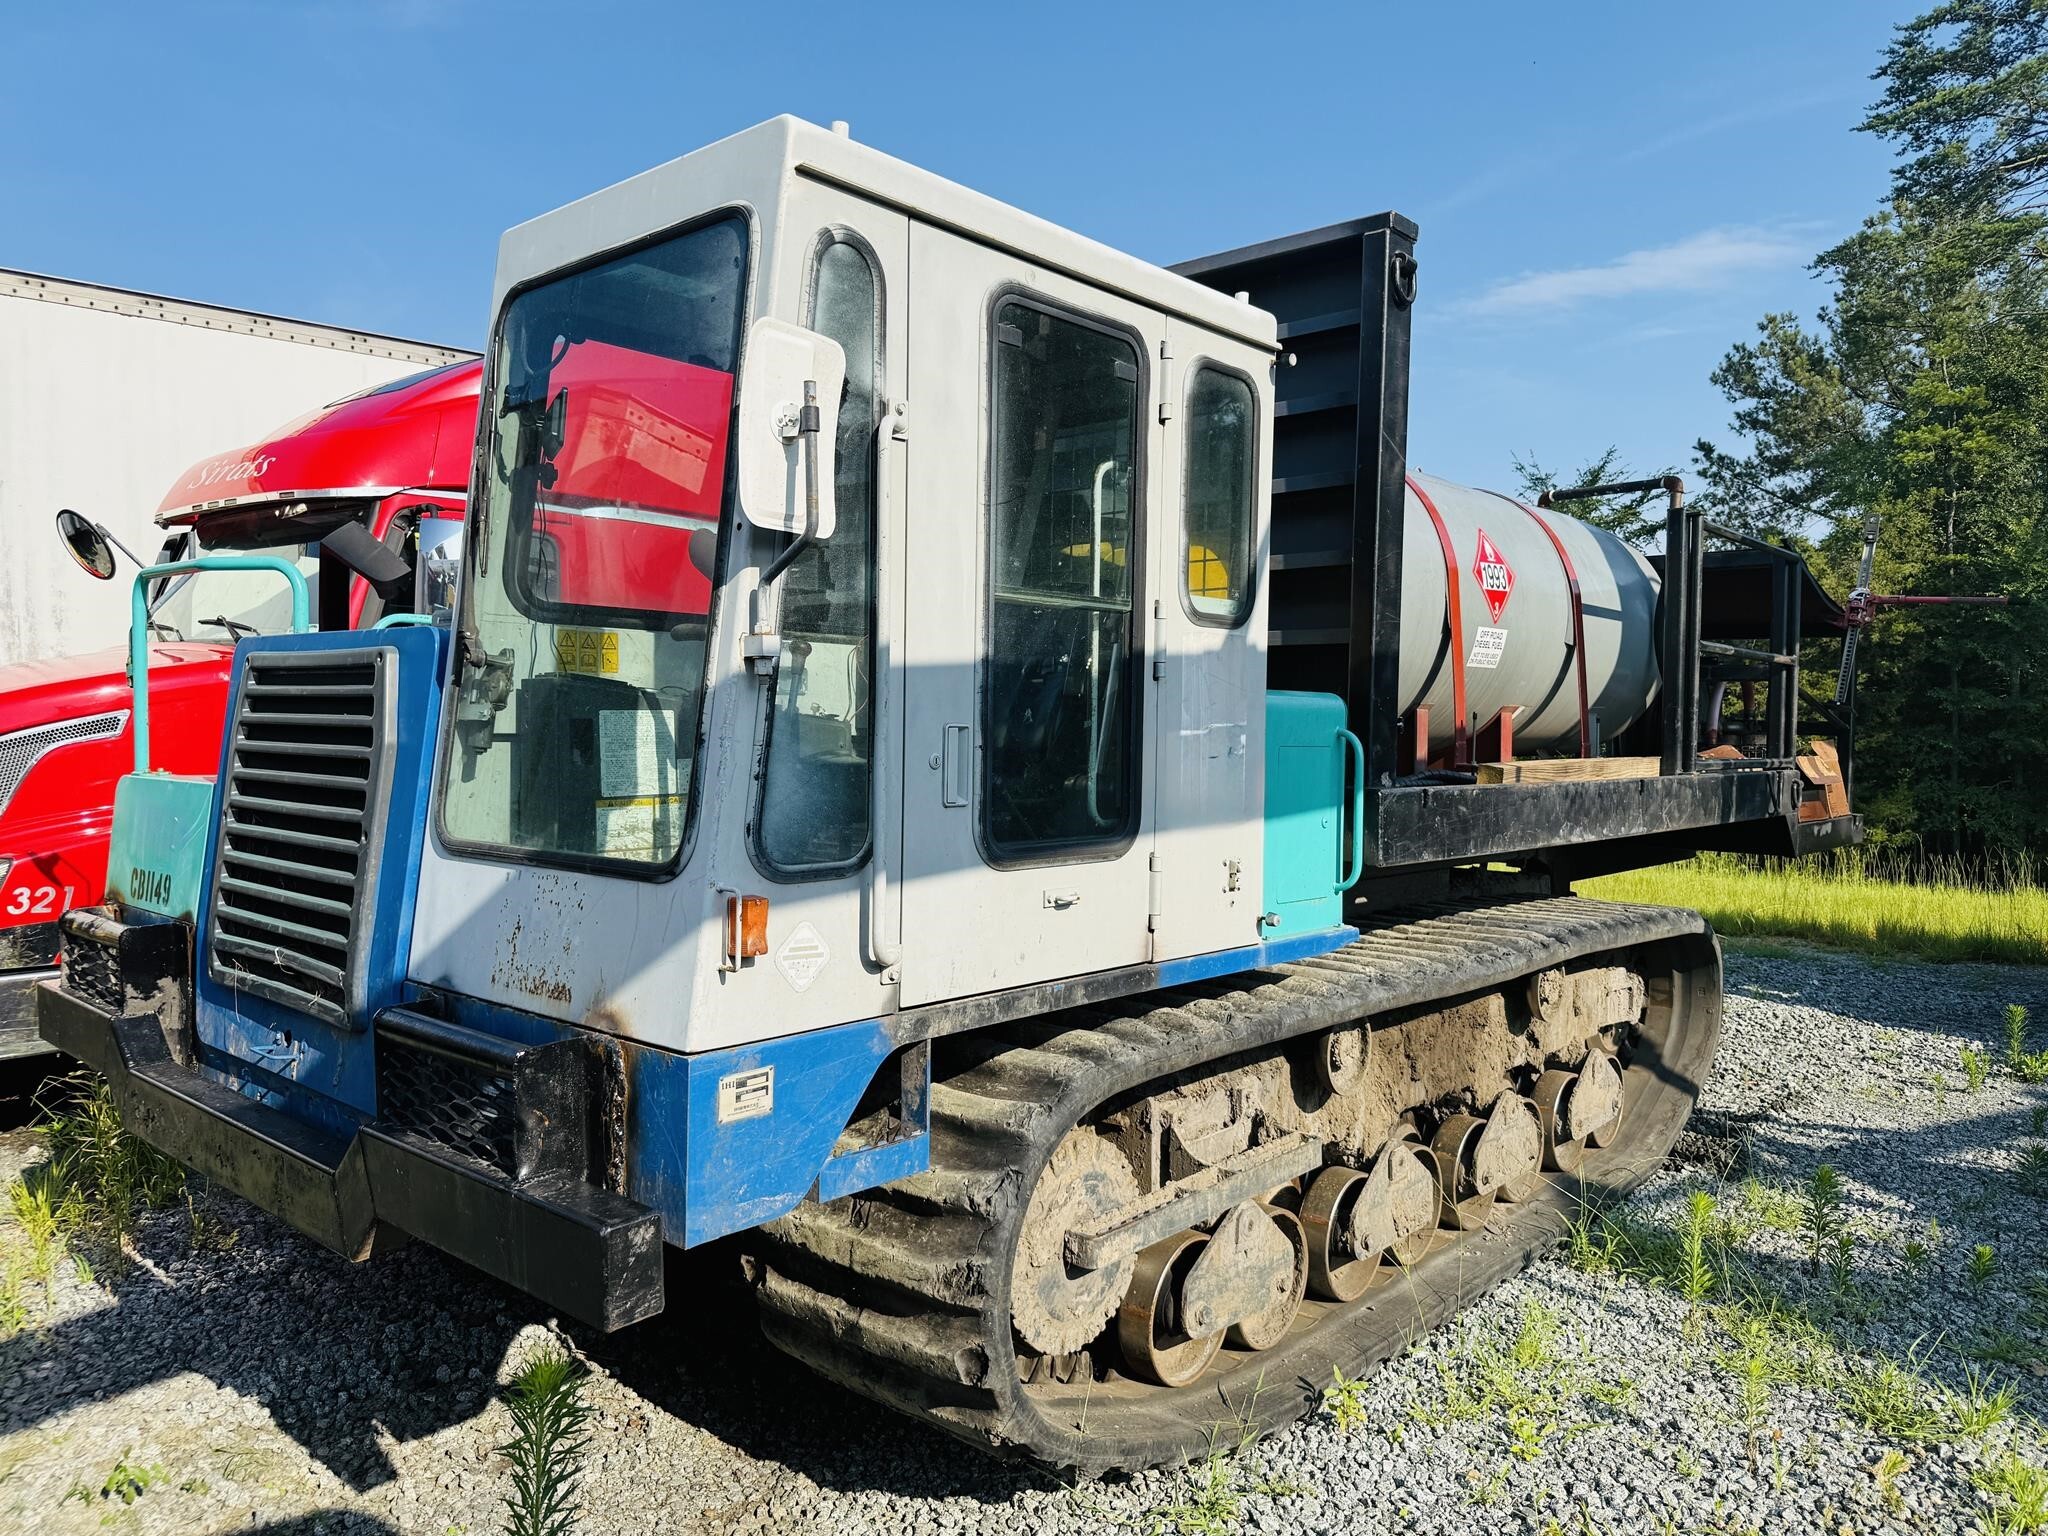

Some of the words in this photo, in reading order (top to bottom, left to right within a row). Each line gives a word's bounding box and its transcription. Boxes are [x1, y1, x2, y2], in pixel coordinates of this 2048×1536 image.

[1483, 565, 1506, 589] 1993
[1493, 602, 1499, 615] 3
[1480, 630, 1490, 638] OFF
[1490, 631, 1503, 640] ROAD
[1474, 640, 1490, 649] DIESEL
[1491, 641, 1503, 650] FUEL
[130, 867, 172, 907] CB1149
[6, 886, 75, 915] 321
